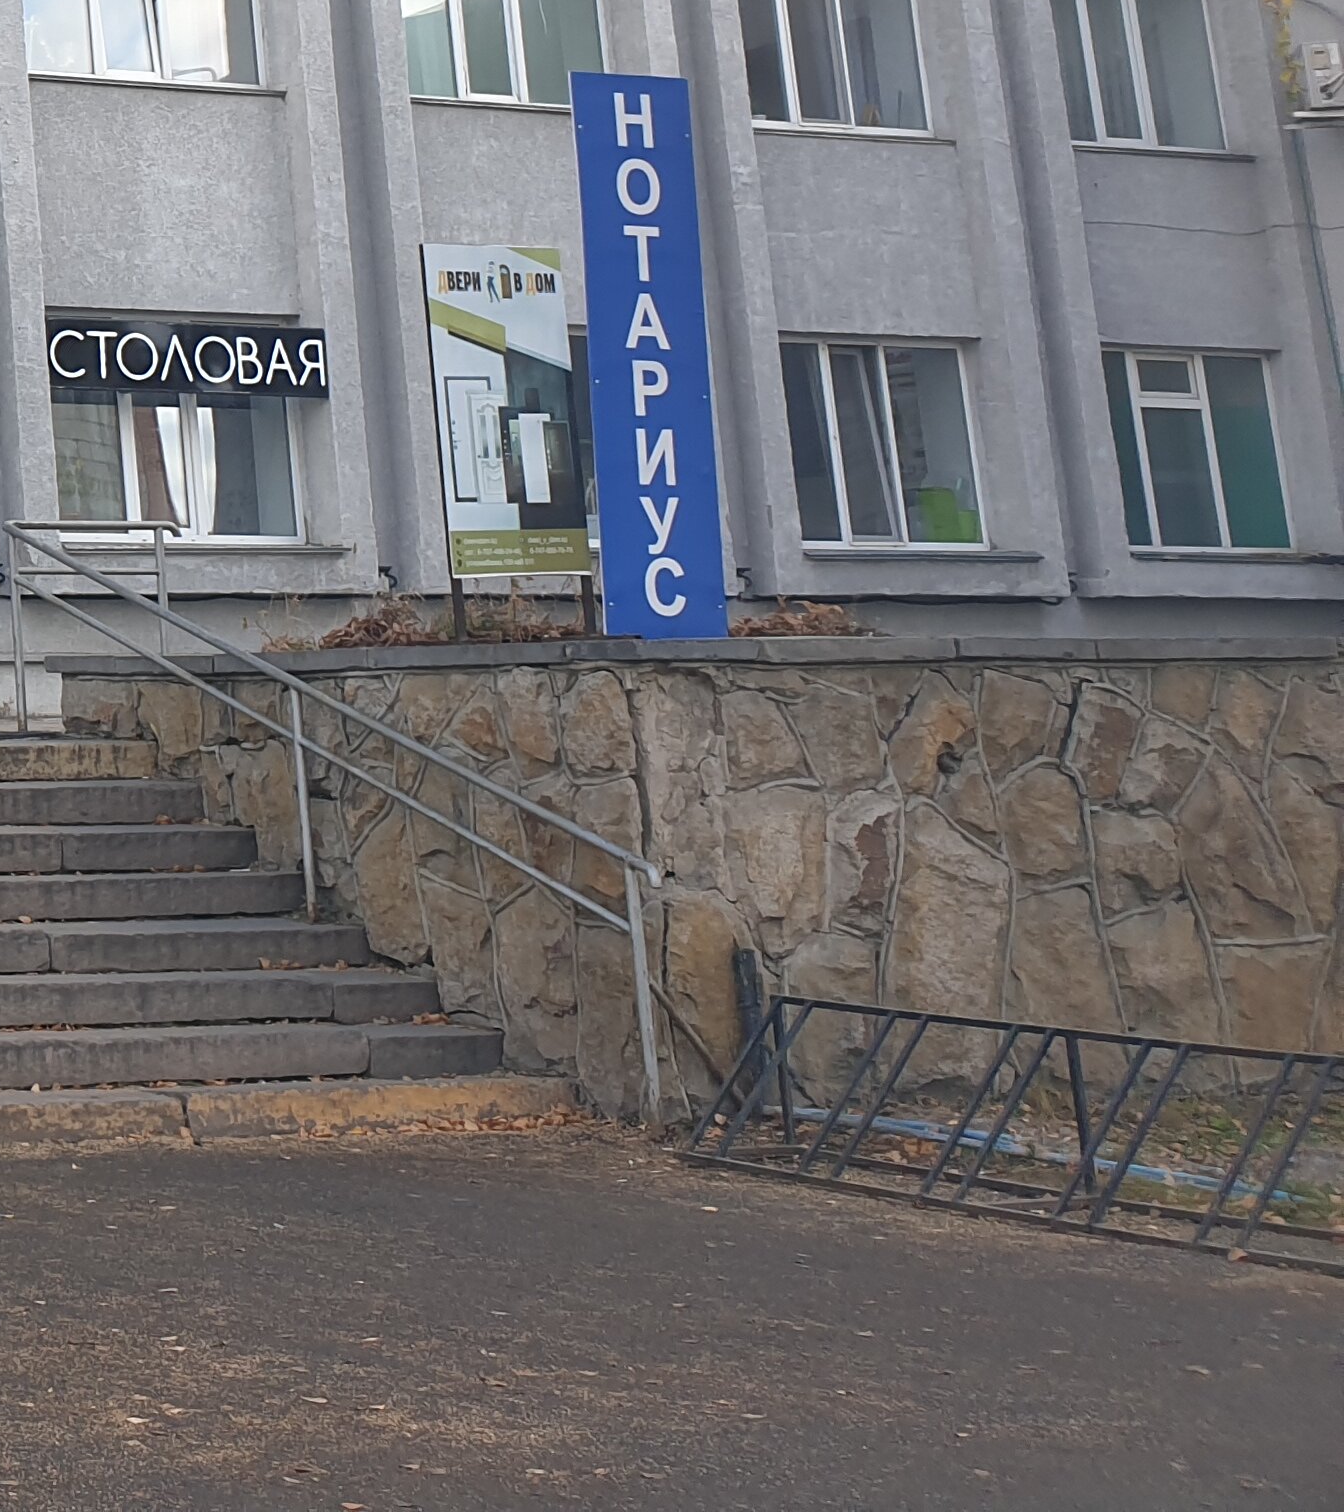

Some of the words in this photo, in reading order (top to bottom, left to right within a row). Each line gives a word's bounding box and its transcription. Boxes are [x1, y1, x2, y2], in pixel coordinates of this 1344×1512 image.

[438, 270, 481, 294] ДВЕРИ
[513, 273, 523, 293] В
[526, 273, 556, 296] ДОМ
[49, 330, 326, 387] СТОЛОВАЯ
[614, 92, 687, 618] НОТАРИУС
